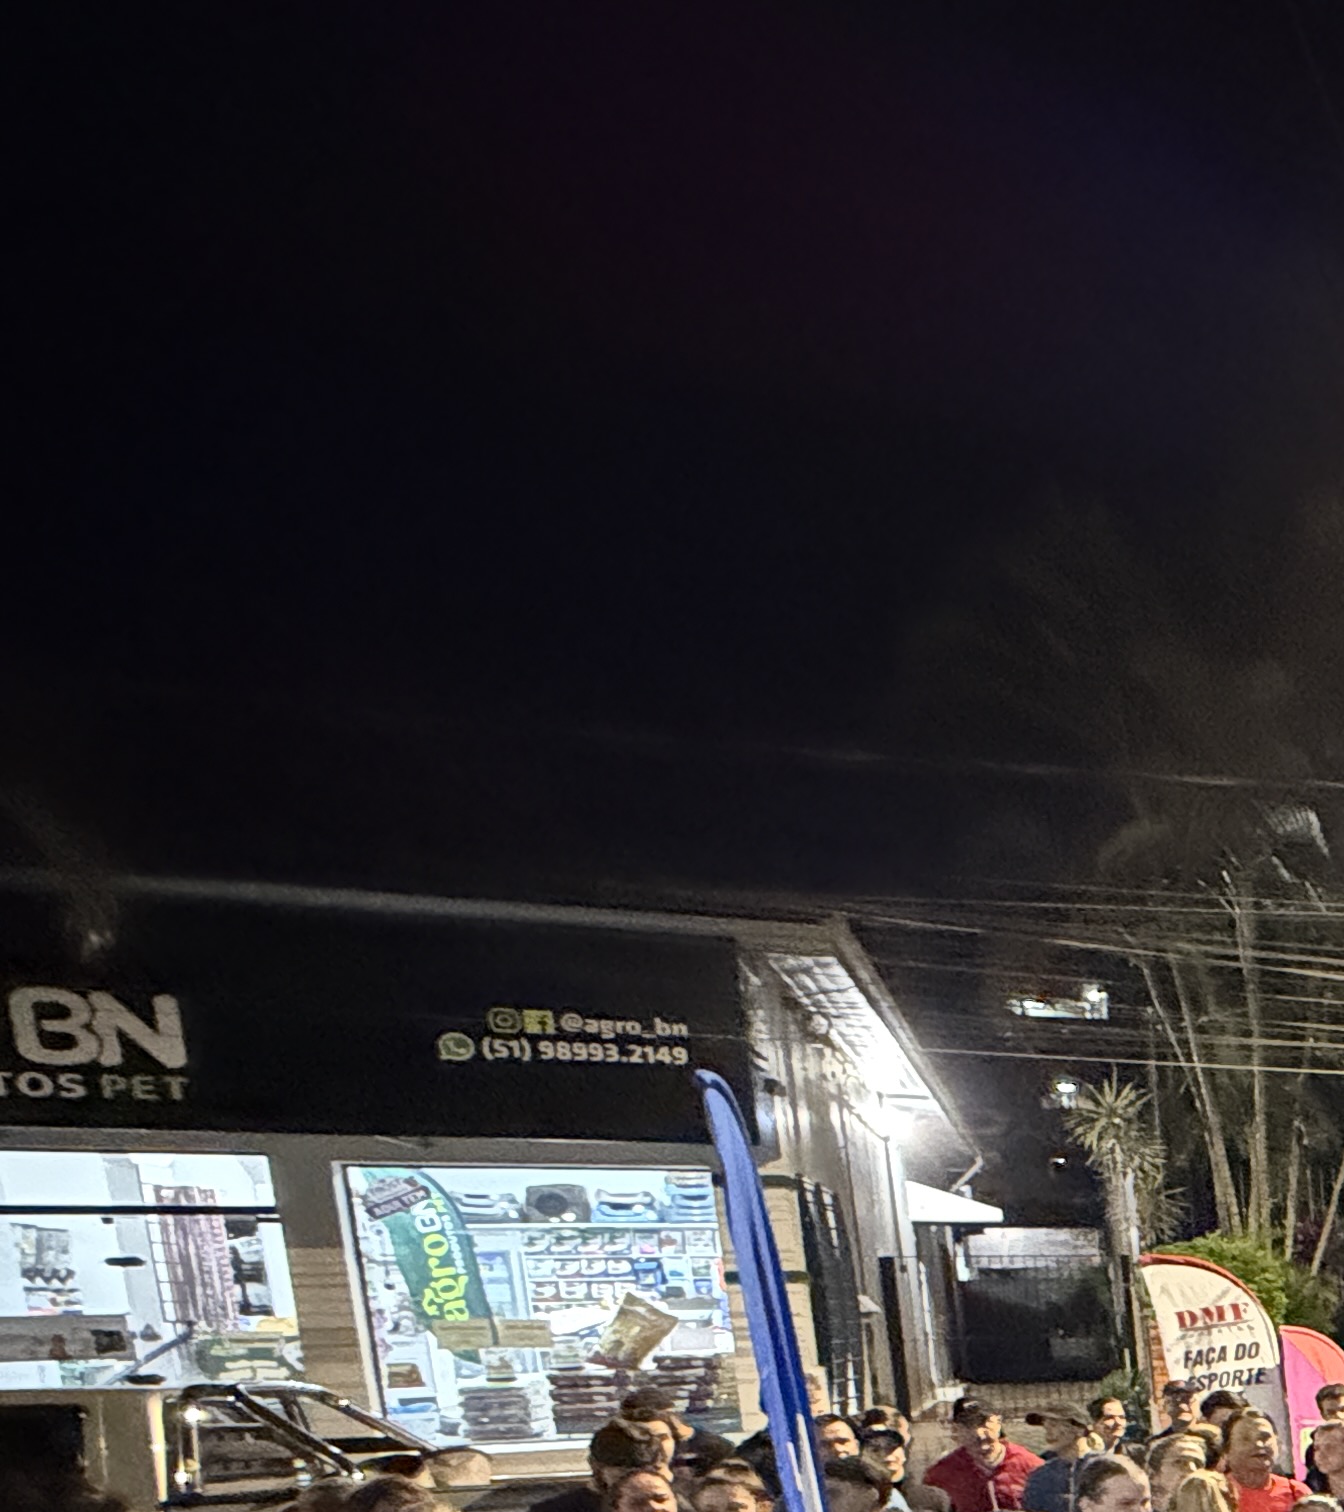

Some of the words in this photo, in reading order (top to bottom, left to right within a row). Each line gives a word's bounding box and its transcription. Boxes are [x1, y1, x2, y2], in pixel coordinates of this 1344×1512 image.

[8, 986, 188, 1069] BN
[560, 1012, 688, 1039] @agro_bn
[482, 1036, 531, 1062] (51)
[537, 1041, 689, 1066] 98993.2149
[101, 1074, 189, 1101] PET
[1184, 1345, 1227, 1371] FAÇA
[1234, 1341, 1260, 1361] DO
